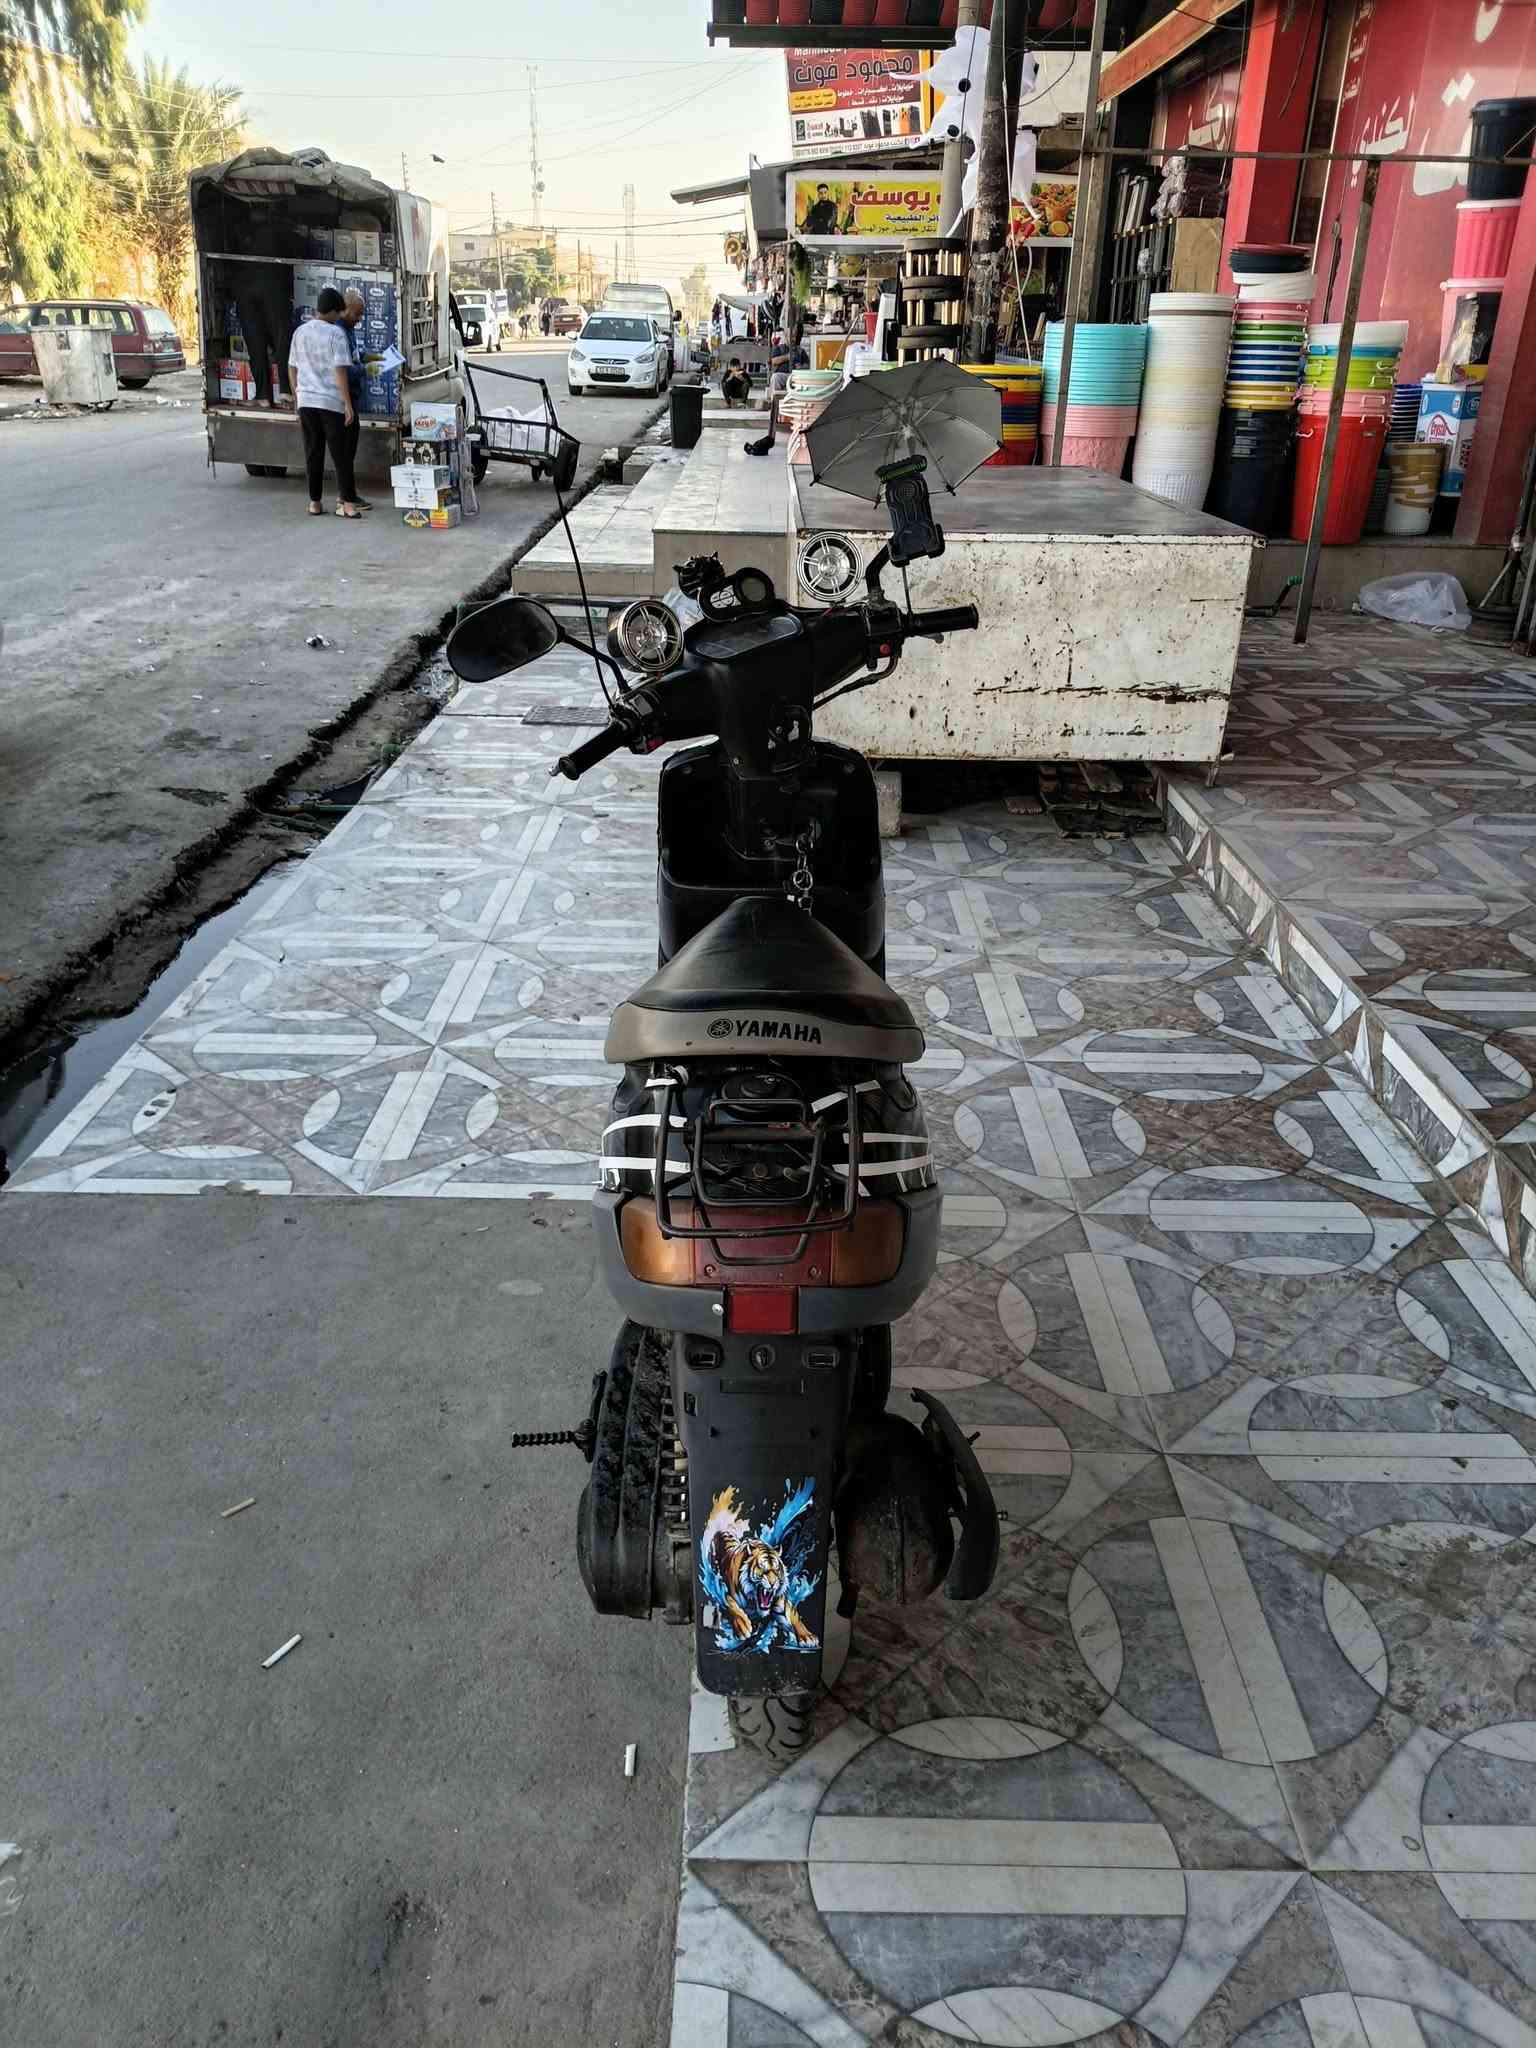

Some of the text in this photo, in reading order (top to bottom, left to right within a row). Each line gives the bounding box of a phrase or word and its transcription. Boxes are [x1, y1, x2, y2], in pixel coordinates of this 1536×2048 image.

[793, 55, 914, 89] محمود فون
[850, 184, 931, 213] يوسف
[736, 1020, 822, 1045] YAMAHA
